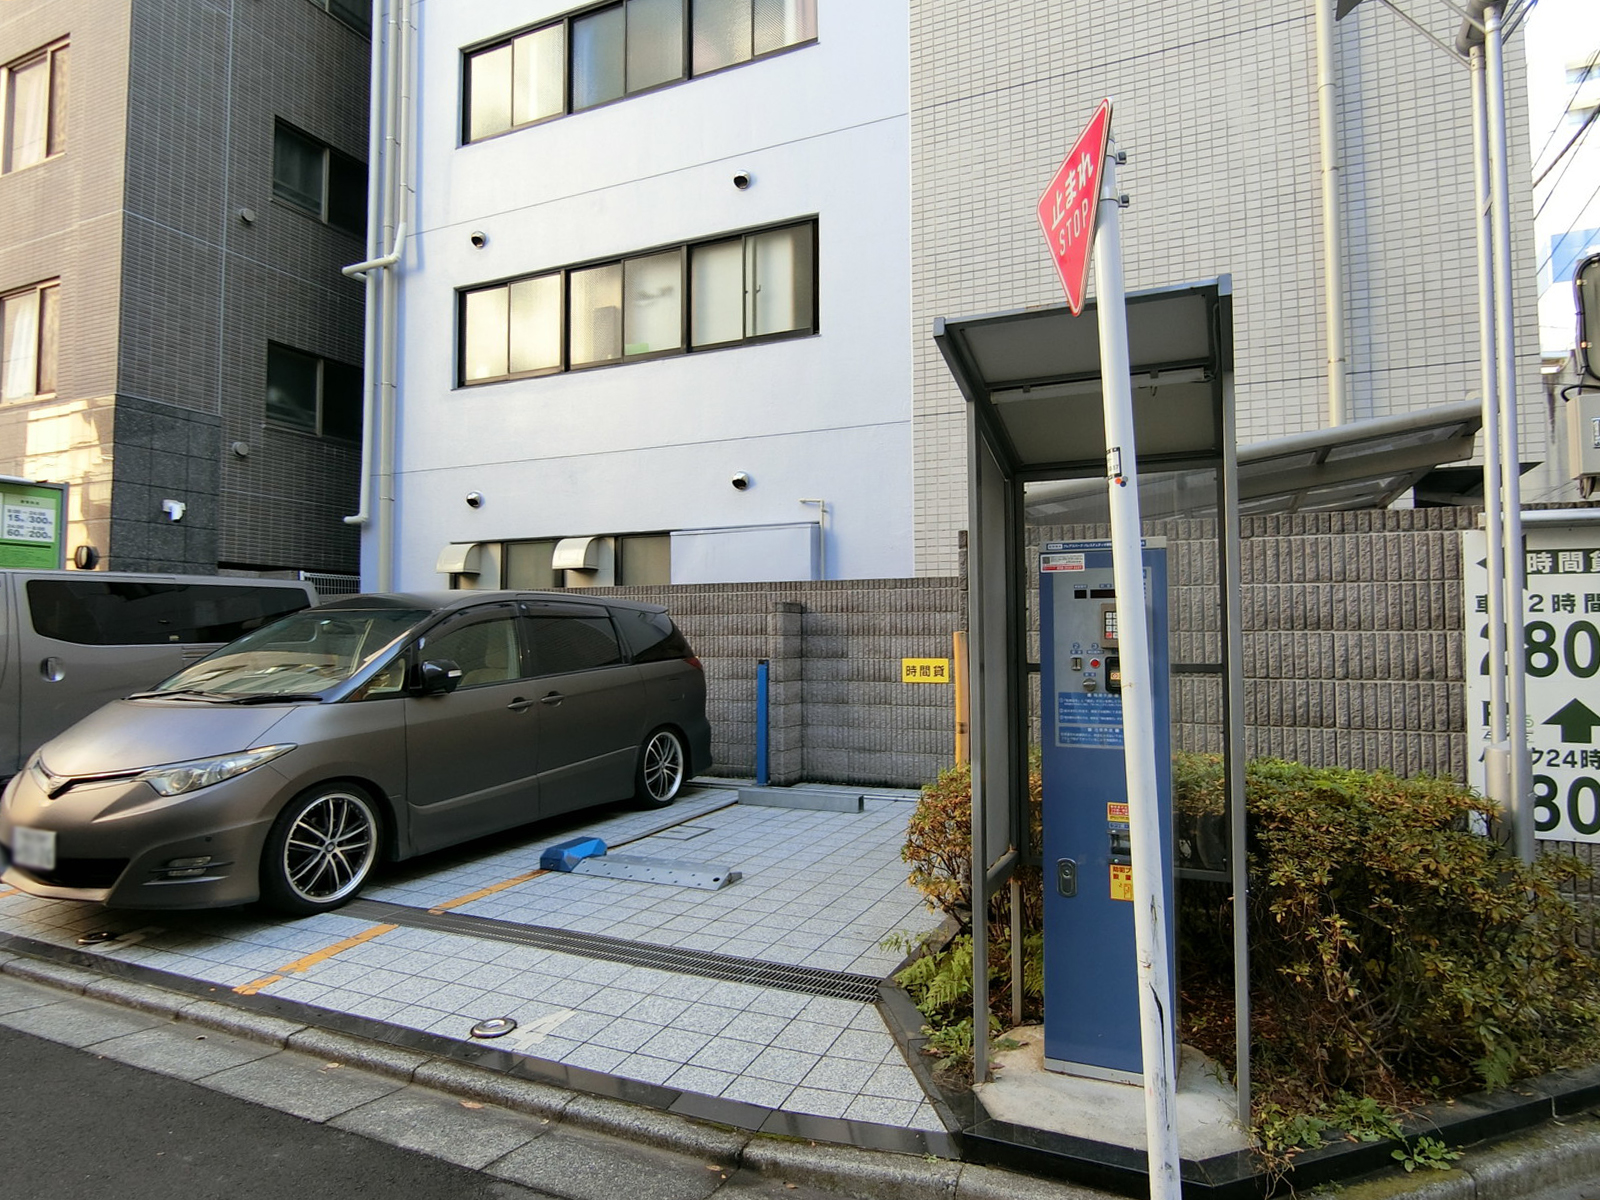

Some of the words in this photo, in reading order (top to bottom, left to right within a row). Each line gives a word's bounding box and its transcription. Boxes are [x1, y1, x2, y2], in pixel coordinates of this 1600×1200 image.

[1051, 152, 1094, 231] 止まれ
[1059, 198, 1090, 256] STOP
[905, 665, 945, 678] 時間貸
